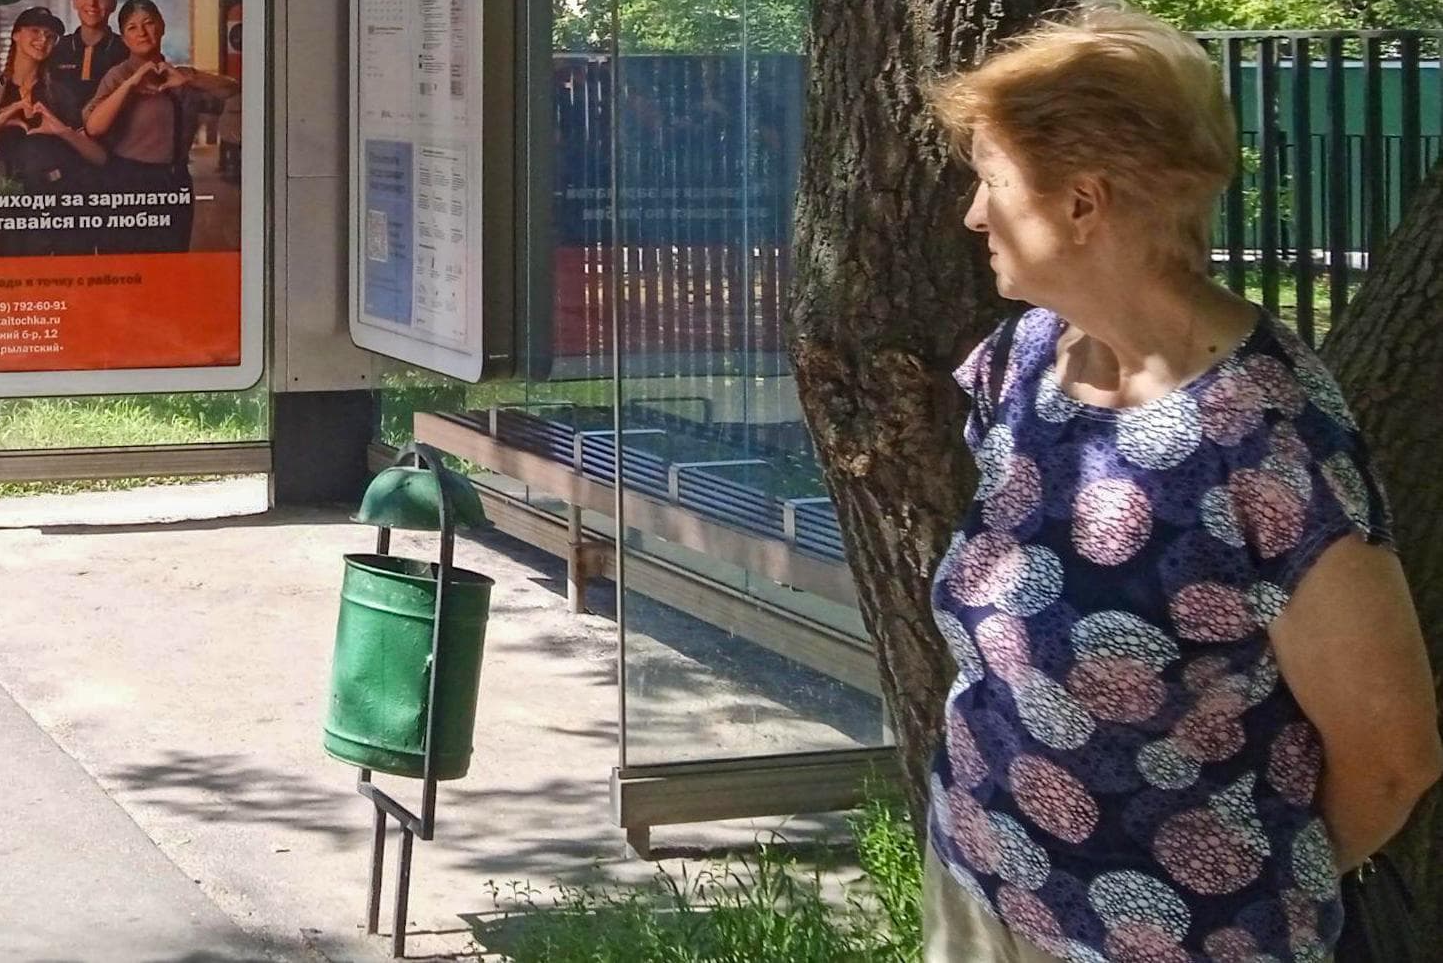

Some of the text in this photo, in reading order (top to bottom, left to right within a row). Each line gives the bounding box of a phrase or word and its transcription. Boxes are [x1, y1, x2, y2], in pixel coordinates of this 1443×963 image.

[60, 193, 84, 207] за
[88, 188, 191, 209] зарплатой
[79, 214, 103, 228] по
[107, 212, 171, 228] любви
[76, 276, 85, 285] с
[87, 273, 142, 286] работой
[13, 301, 68, 312] 792-60-91
[43, 329, 59, 339] 12
